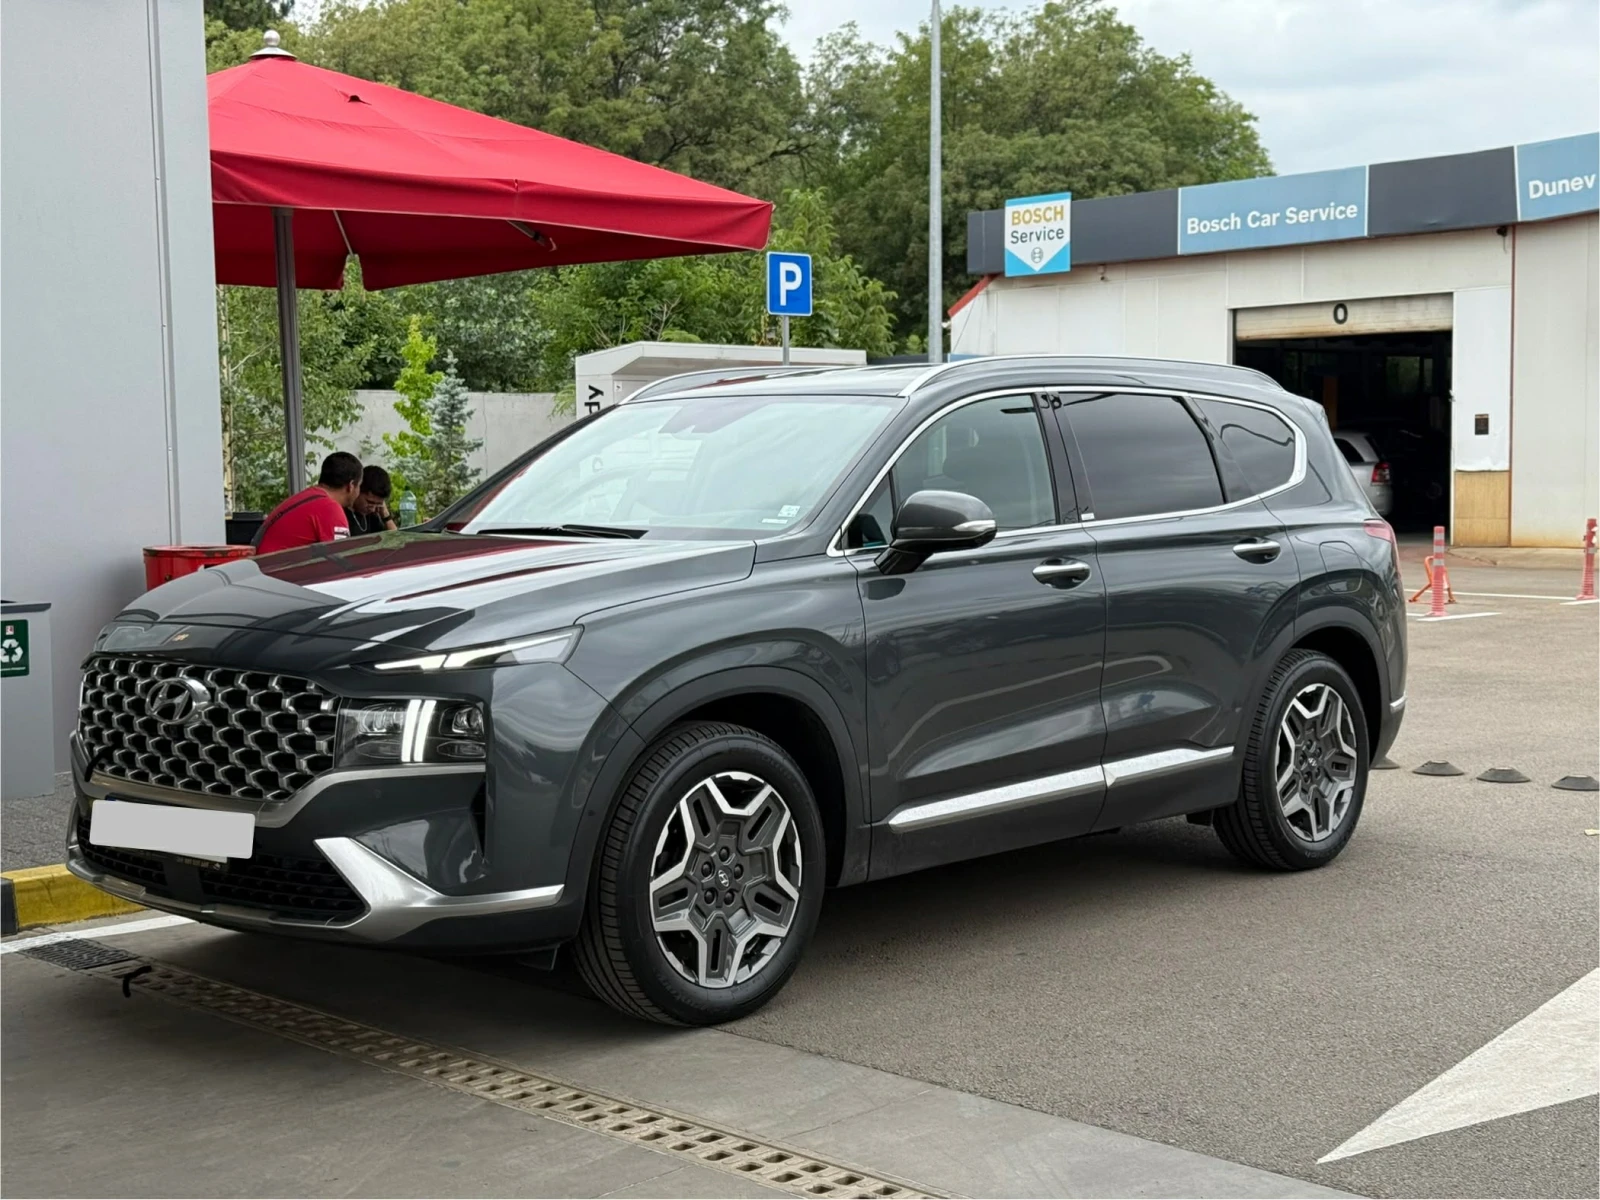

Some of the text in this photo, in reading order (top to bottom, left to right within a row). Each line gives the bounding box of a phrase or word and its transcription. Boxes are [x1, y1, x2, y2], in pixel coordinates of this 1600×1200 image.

[1528, 173, 1597, 199] Dunev
[1011, 205, 1065, 226] BOSCH
[1186, 201, 1359, 235] Bosch Car Service
[1010, 226, 1065, 245] Service
[779, 261, 803, 307] P
